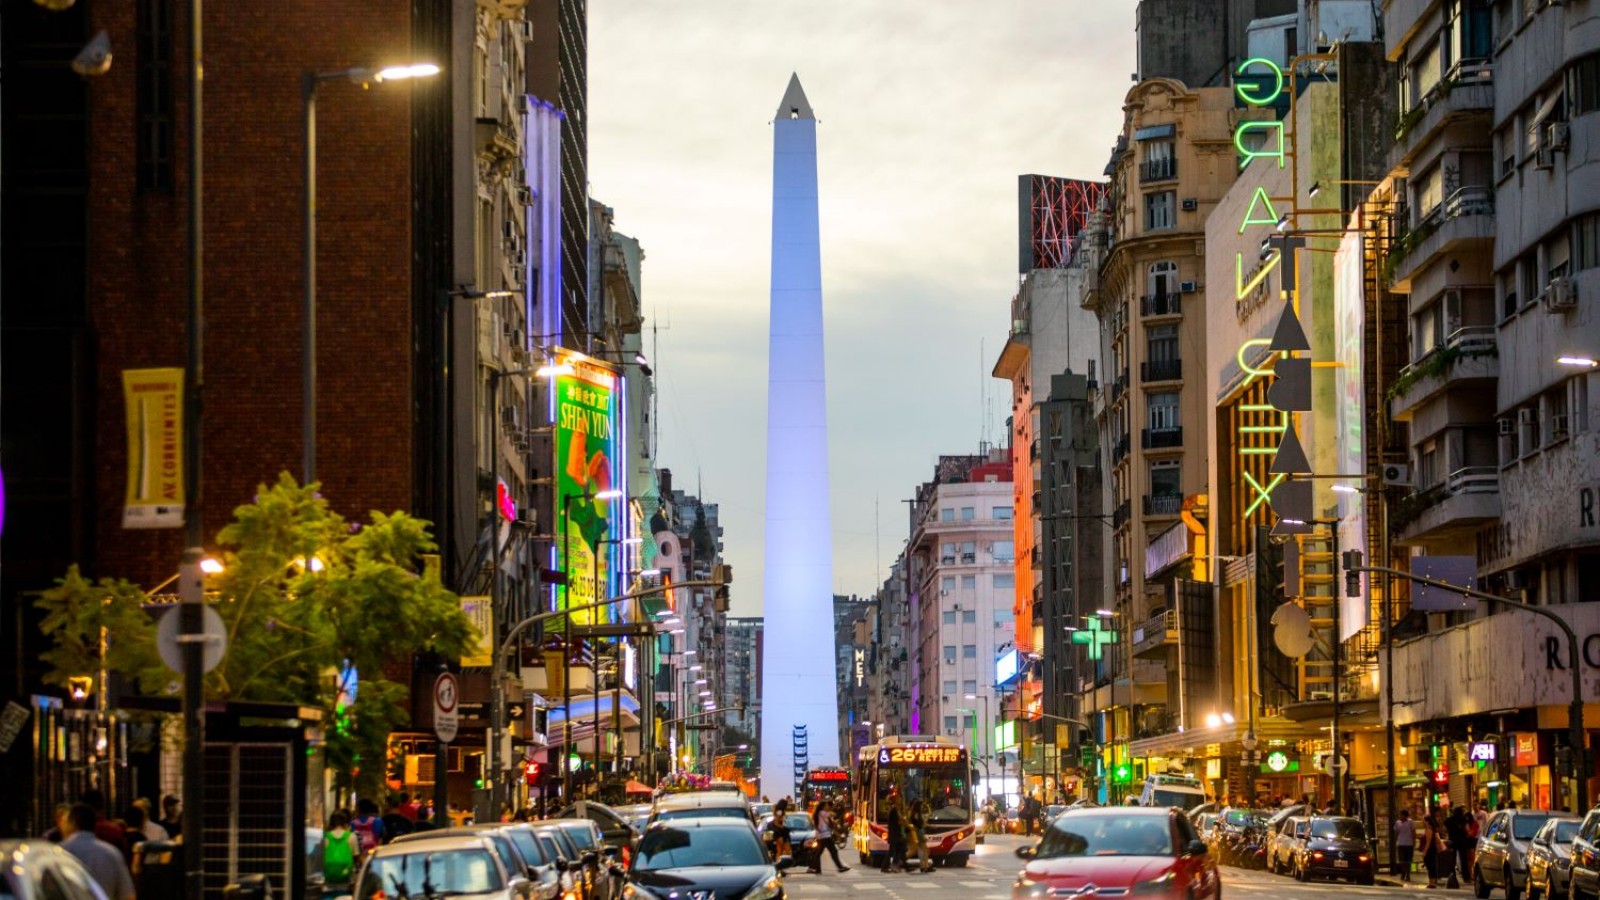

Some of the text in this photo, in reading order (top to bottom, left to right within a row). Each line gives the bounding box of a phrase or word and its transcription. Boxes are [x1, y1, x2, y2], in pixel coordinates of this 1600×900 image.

[163, 393, 176, 478] CORRIENTES
[561, 402, 613, 441] SHEN YUN
[163, 482, 176, 500] AV
[855, 648, 865, 688] MET
[891, 749, 916, 763] 26
[1470, 743, 1495, 760] ASH
